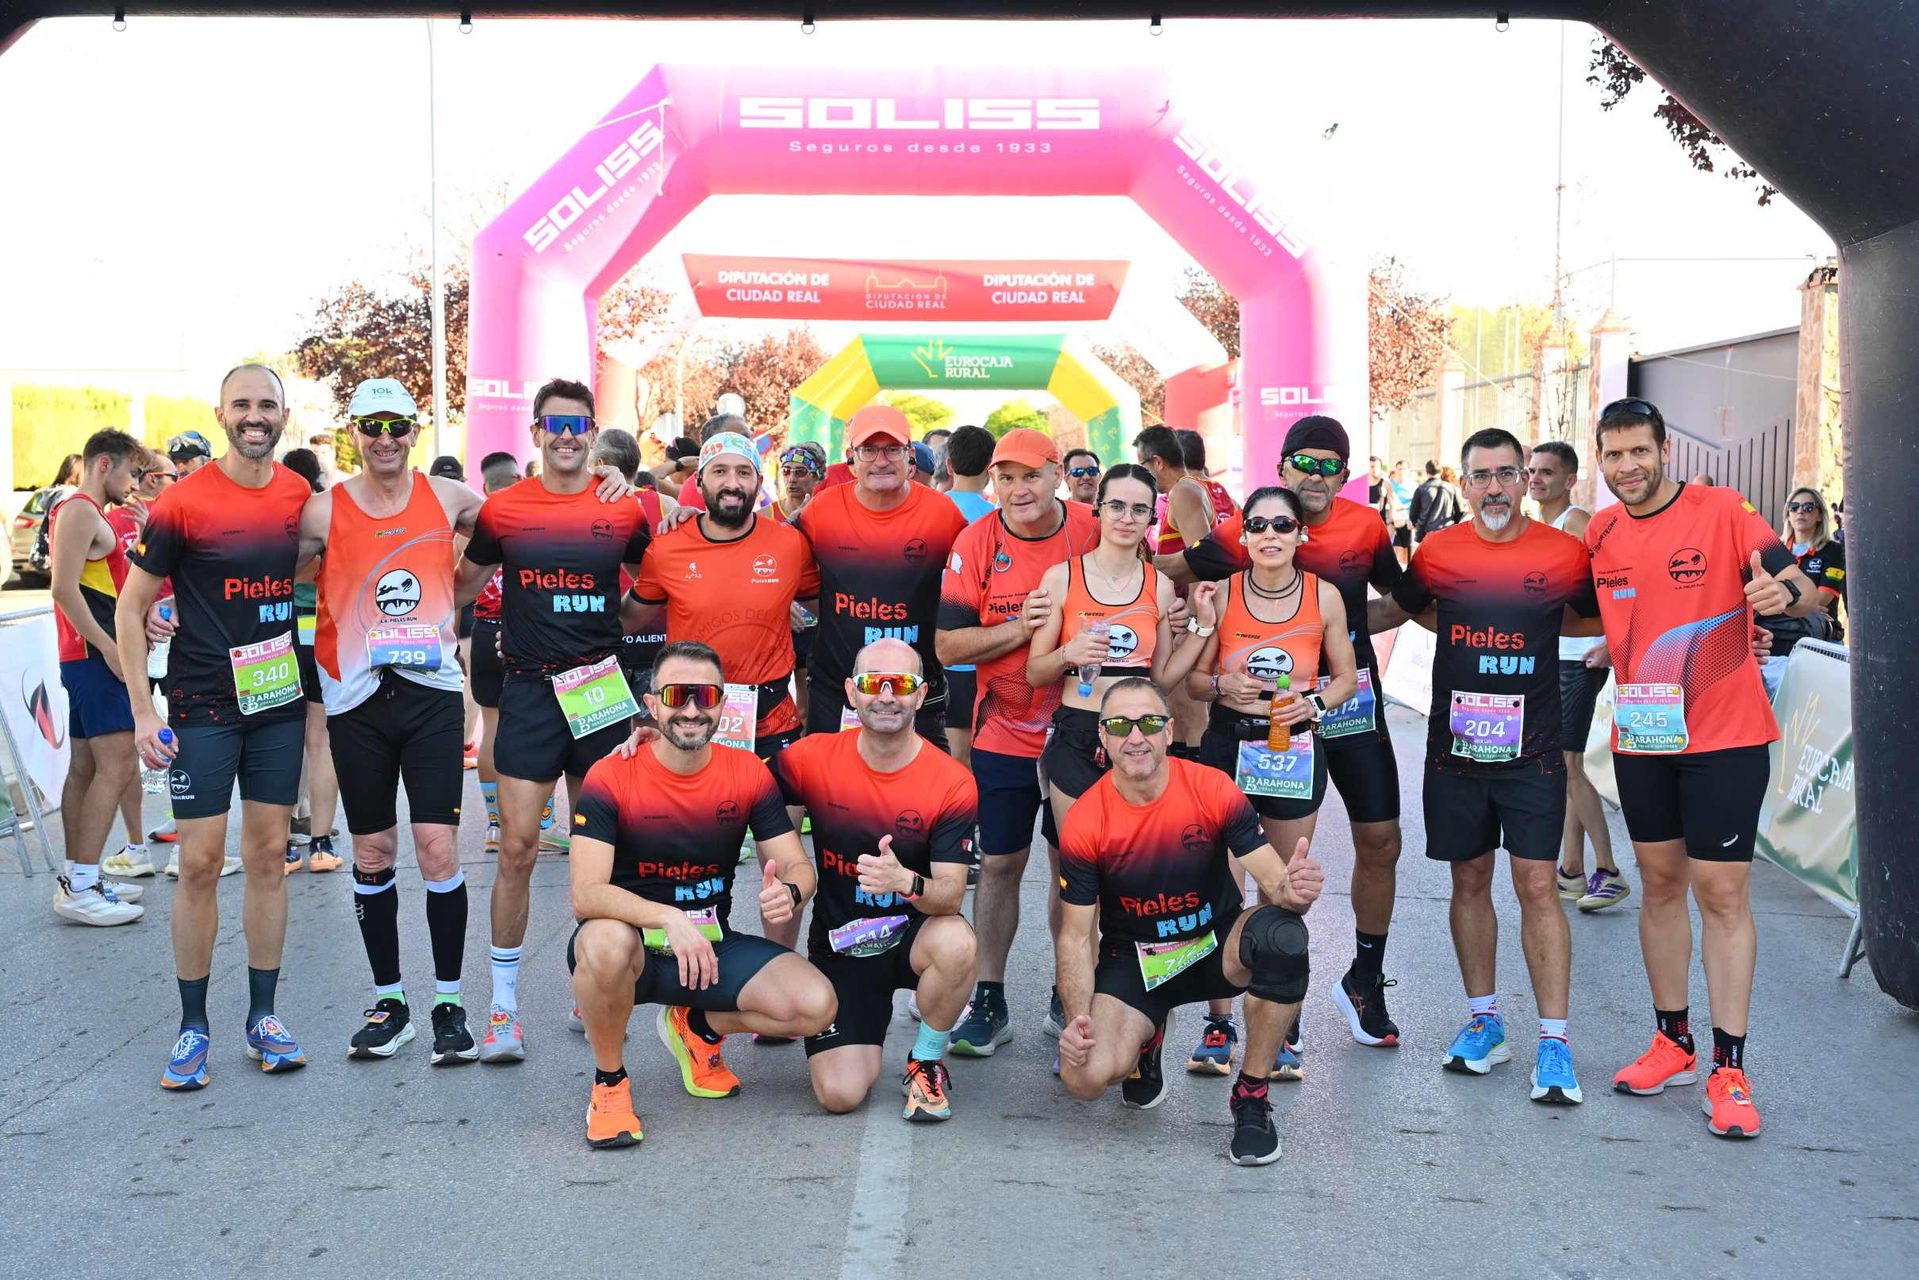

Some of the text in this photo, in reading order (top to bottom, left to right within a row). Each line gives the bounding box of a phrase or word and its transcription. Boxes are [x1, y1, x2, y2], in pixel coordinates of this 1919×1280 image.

[740, 96, 1100, 130] SOLISS
[789, 140, 1052, 155] Seguros desde 1933
[523, 119, 665, 254] SOLISS
[1172, 128, 1308, 260] SOLISS
[562, 213, 607, 252] Seguros
[606, 186, 637, 214] desde
[1177, 164, 1272, 257] Seguros desde 1933
[718, 269, 830, 287] DIPUTACIÓN DE
[983, 271, 1096, 288] DIPUTACIÓN DE
[726, 288, 822, 304] CIUDAD REAL
[865, 299, 947, 309] CIUDAD REAL
[992, 289, 1087, 305] CIUDAD REAL
[945, 355, 1013, 369] EUROCAJA
[945, 368, 991, 379] RURAL
[372, 387, 393, 395] 10k
[224, 575, 293, 601] Pieles
[519, 568, 596, 590] Pieles
[1596, 576, 1629, 589] Pieles
[553, 594, 606, 613] RUN
[1612, 588, 1637, 600] RUN
[259, 601, 293, 623] RU
[835, 591, 909, 621] Pieles
[1450, 624, 1526, 650] Pieles
[233, 634, 291, 661] SOLISS
[387, 650, 427, 665] 739
[1478, 655, 1536, 675] RUN
[252, 661, 290, 688] 340
[583, 685, 605, 706] 10
[1454, 693, 1520, 708] SOLISS
[718, 716, 744, 733] 02
[1464, 719, 1506, 738] 204
[1630, 711, 1668, 727] 245
[1257, 753, 1298, 772] 537
[638, 861, 721, 880] Pieles
[822, 847, 860, 878] Pie
[675, 877, 726, 901] RUN
[1119, 891, 1200, 917] Pieles
[1156, 901, 1213, 938] RUN
